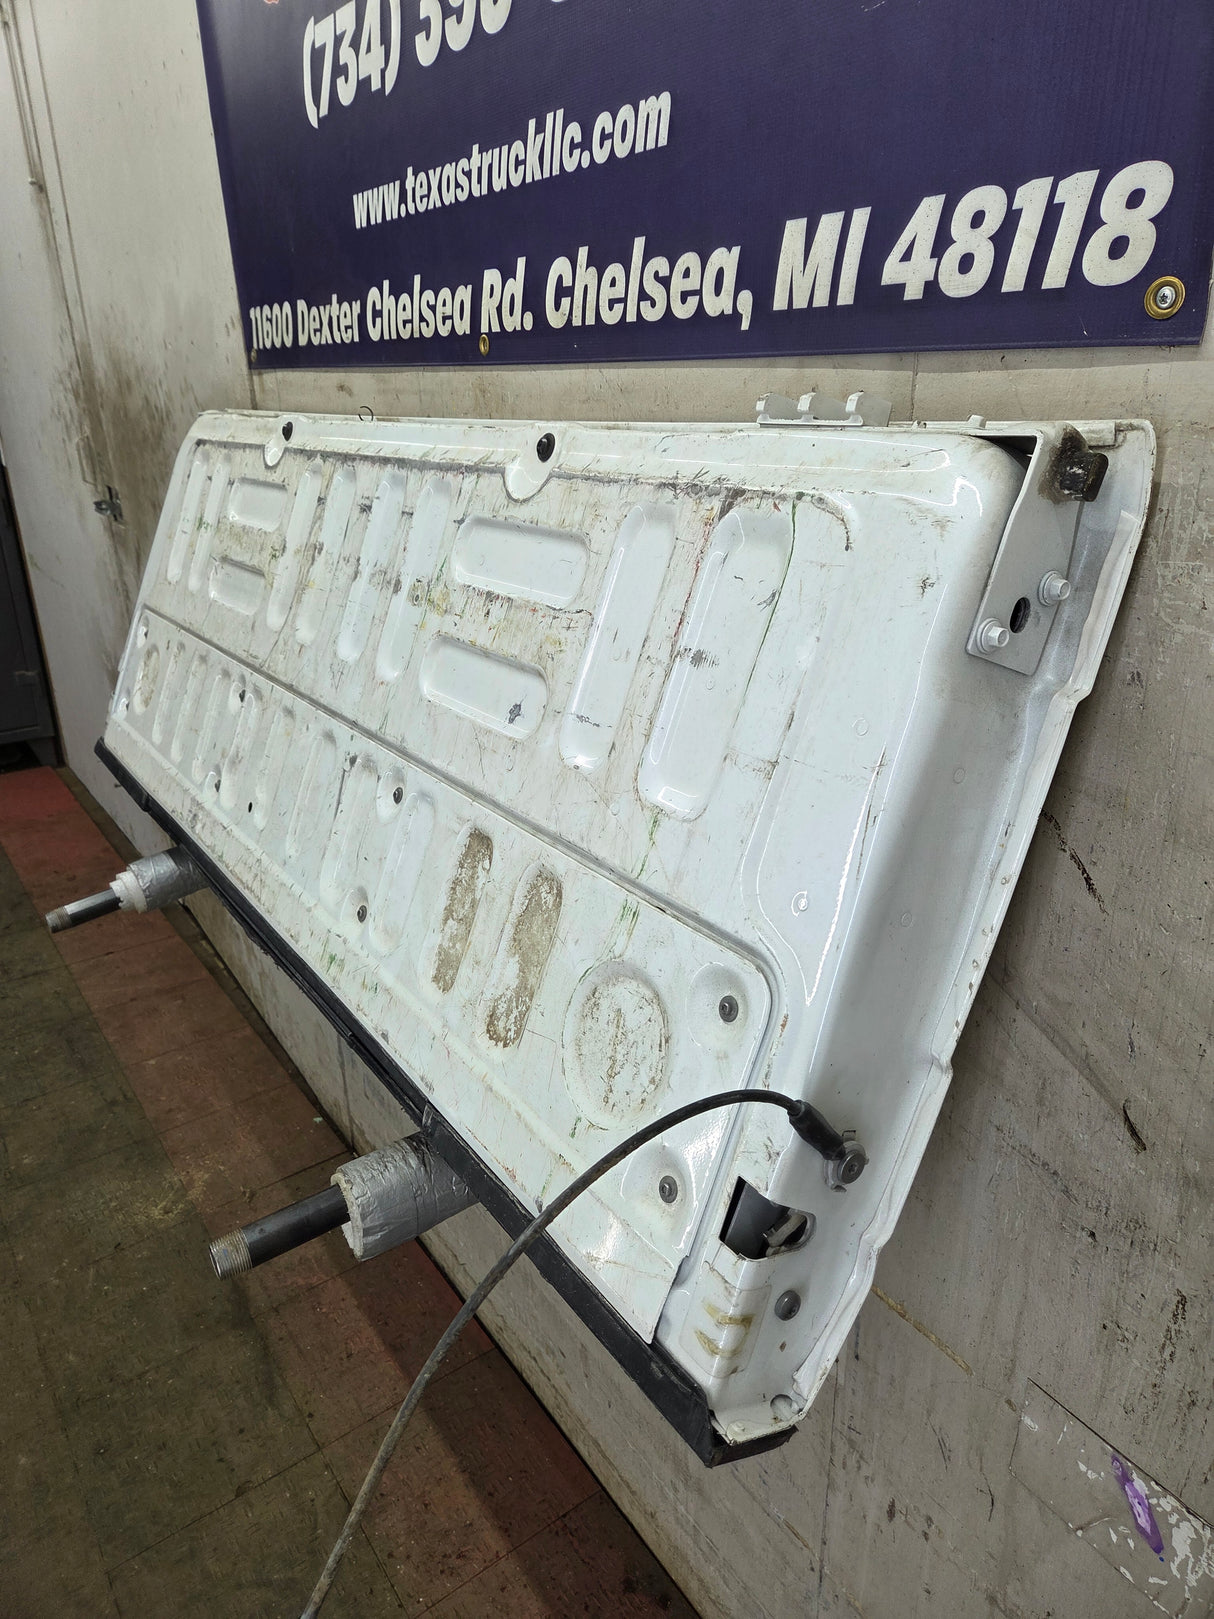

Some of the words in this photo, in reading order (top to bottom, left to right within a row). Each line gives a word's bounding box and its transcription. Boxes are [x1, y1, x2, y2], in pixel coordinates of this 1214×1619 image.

[303, 0, 402, 129] (734)
[353, 91, 672, 230] www.texastruckllc.com
[249, 300, 294, 350] 11600
[297, 294, 361, 346] Dexter
[366, 274, 473, 342] Chelsea
[480, 256, 534, 334] Rd.
[545, 236, 754, 331] Chelsea,
[772, 206, 872, 311] MI
[880, 159, 1175, 301] 48118
